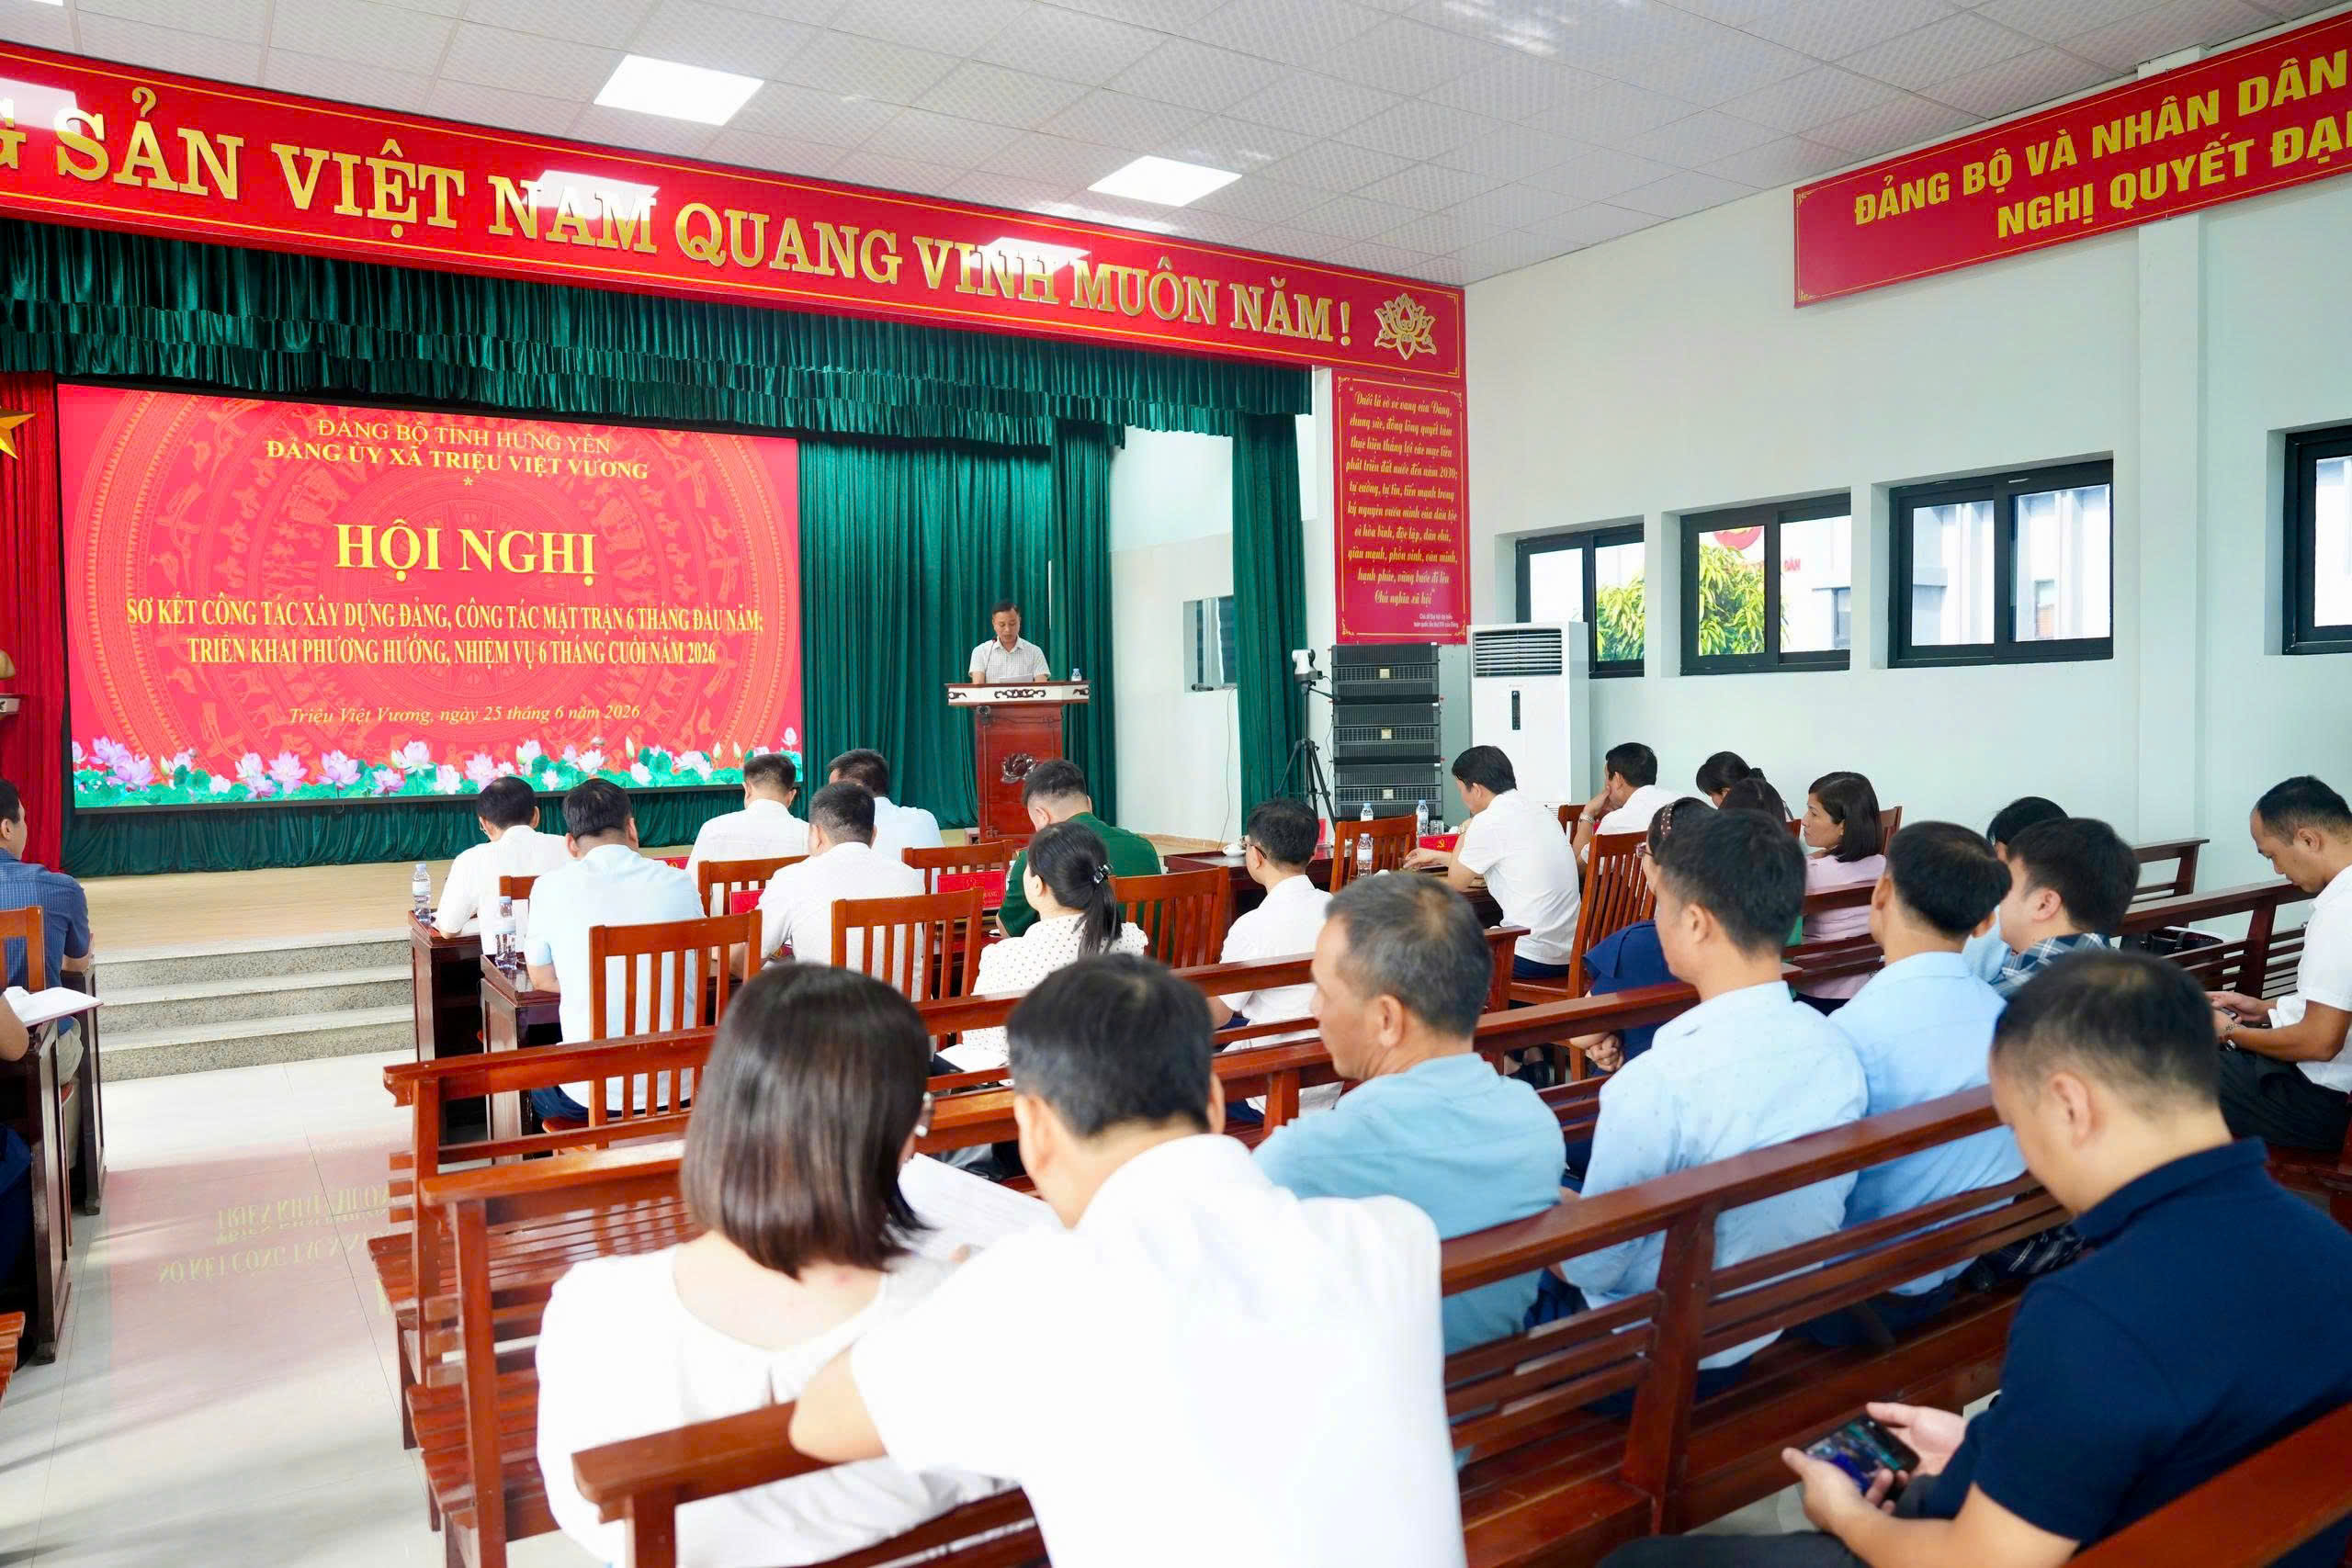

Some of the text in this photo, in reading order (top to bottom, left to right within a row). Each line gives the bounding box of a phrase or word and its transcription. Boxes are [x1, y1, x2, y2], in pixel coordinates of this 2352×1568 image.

[1854, 49, 2346, 226] ĐẢNG BỘ VÀ NHÂN DÂN
[1997, 182, 2093, 239] NGHỊ
[2110, 130, 2255, 211] QUYẾT
[53, 86, 244, 200] SẢN
[271, 138, 465, 238] VIỆT
[488, 175, 659, 254] NAM
[674, 203, 903, 285] QUANG
[912, 234, 1058, 304] VINH
[1069, 257, 1218, 327] MUÔN
[1229, 276, 1352, 346] NĂM!
[318, 416, 389, 440] ĐẢNG
[397, 422, 428, 446] BỘ
[496, 432, 561, 450] HƯNG
[567, 434, 610, 454] YÊN
[266, 437, 648, 479] ĐẢNG ỦY XÃ TRIỆU VIỆT VƯƠNG
[334, 519, 597, 586] HỘI NGHỊ
[126, 597, 153, 624] SƠ
[158, 591, 196, 625] KẾT
[202, 592, 255, 625] CÔNG
[261, 593, 298, 626] TÁC
[303, 594, 339, 626] XÂY
[345, 601, 394, 632] DỰNG
[399, 596, 451, 632] ĐẢNG,
[455, 597, 503, 628] CÔNG
[506, 599, 538, 629] TÁC
[543, 603, 581, 635] MẶT
[582, 604, 623, 635] TRẬN
[627, 609, 634, 629] 6
[637, 603, 689, 631] THÁNG
[250, 638, 296, 663] KHAI
[302, 636, 379, 663] PHƯƠNG
[383, 633, 450, 667] HƯỚNG,
[455, 637, 508, 669] NHIỆM
[514, 640, 535, 670] VỤ
[538, 641, 547, 663] 6
[551, 635, 605, 663] THÁNG
[608, 634, 650, 663] CUỐI
[650, 636, 684, 663] NĂM
[687, 642, 716, 663] 2026
[289, 707, 333, 724] Triệu
[340, 707, 371, 725] Việt
[441, 706, 478, 722] ngày
[484, 706, 501, 720] 25
[508, 705, 549, 721] tháng
[555, 706, 563, 719] 6
[569, 706, 599, 719] năm
[605, 705, 639, 718] 2026
